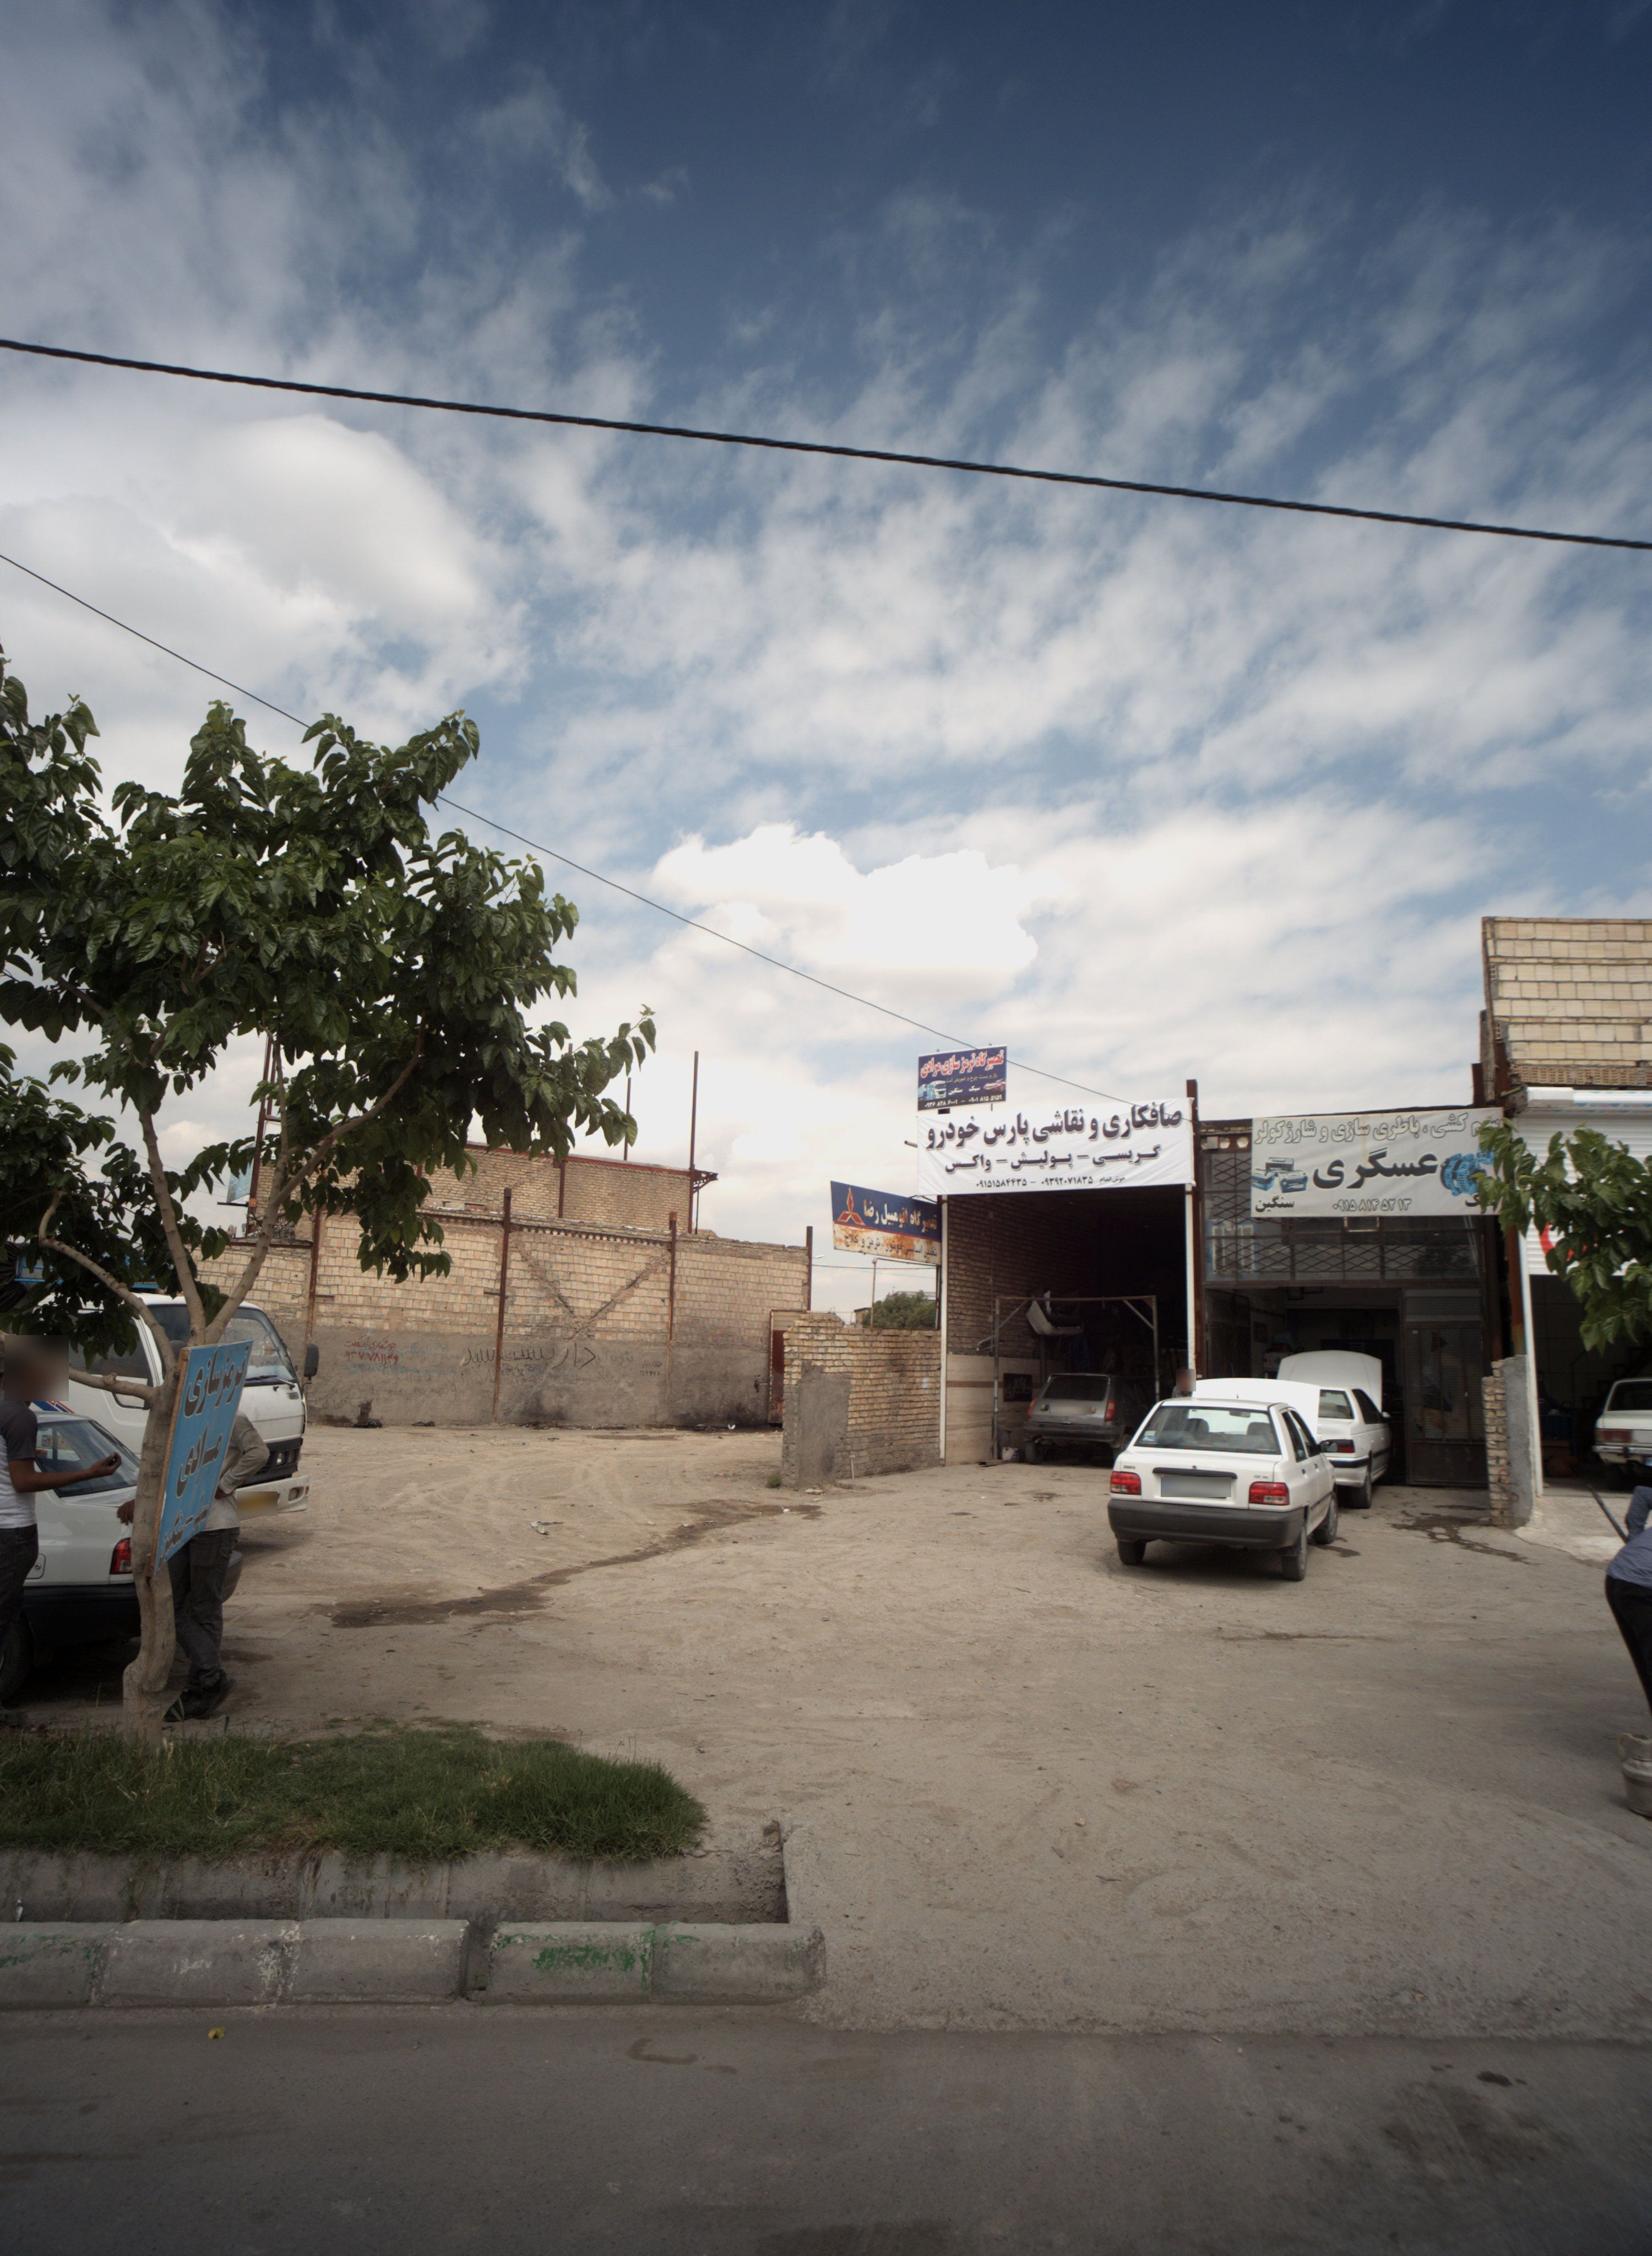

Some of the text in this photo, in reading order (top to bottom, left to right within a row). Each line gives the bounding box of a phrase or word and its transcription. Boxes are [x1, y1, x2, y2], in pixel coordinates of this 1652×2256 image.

[920, 1057, 942, 1078] مرادی
[948, 1087, 963, 1096] سنگین
[926, 1102, 1183, 1150] صافکاری و نقاشی پارس خودرو
[1254, 1120, 1286, 1145] کولر
[1284, 1119, 1317, 1143] شارژ
[1319, 1126, 1329, 1143] و
[1332, 1117, 1370, 1142] سازی
[1373, 1114, 1420, 1141] باطری
[1431, 1111, 1469, 1138] کشی
[945, 1153, 992, 1174] واکس
[1010, 1149, 1073, 1170] پولیش
[1313, 1147, 1439, 1189] عسگری
[863, 1198, 879, 1224] رضا
[881, 1203, 908, 1229] اتومبیل
[1256, 1195, 1295, 1212] سنگین
[176, 1422, 223, 1499] مرادی
